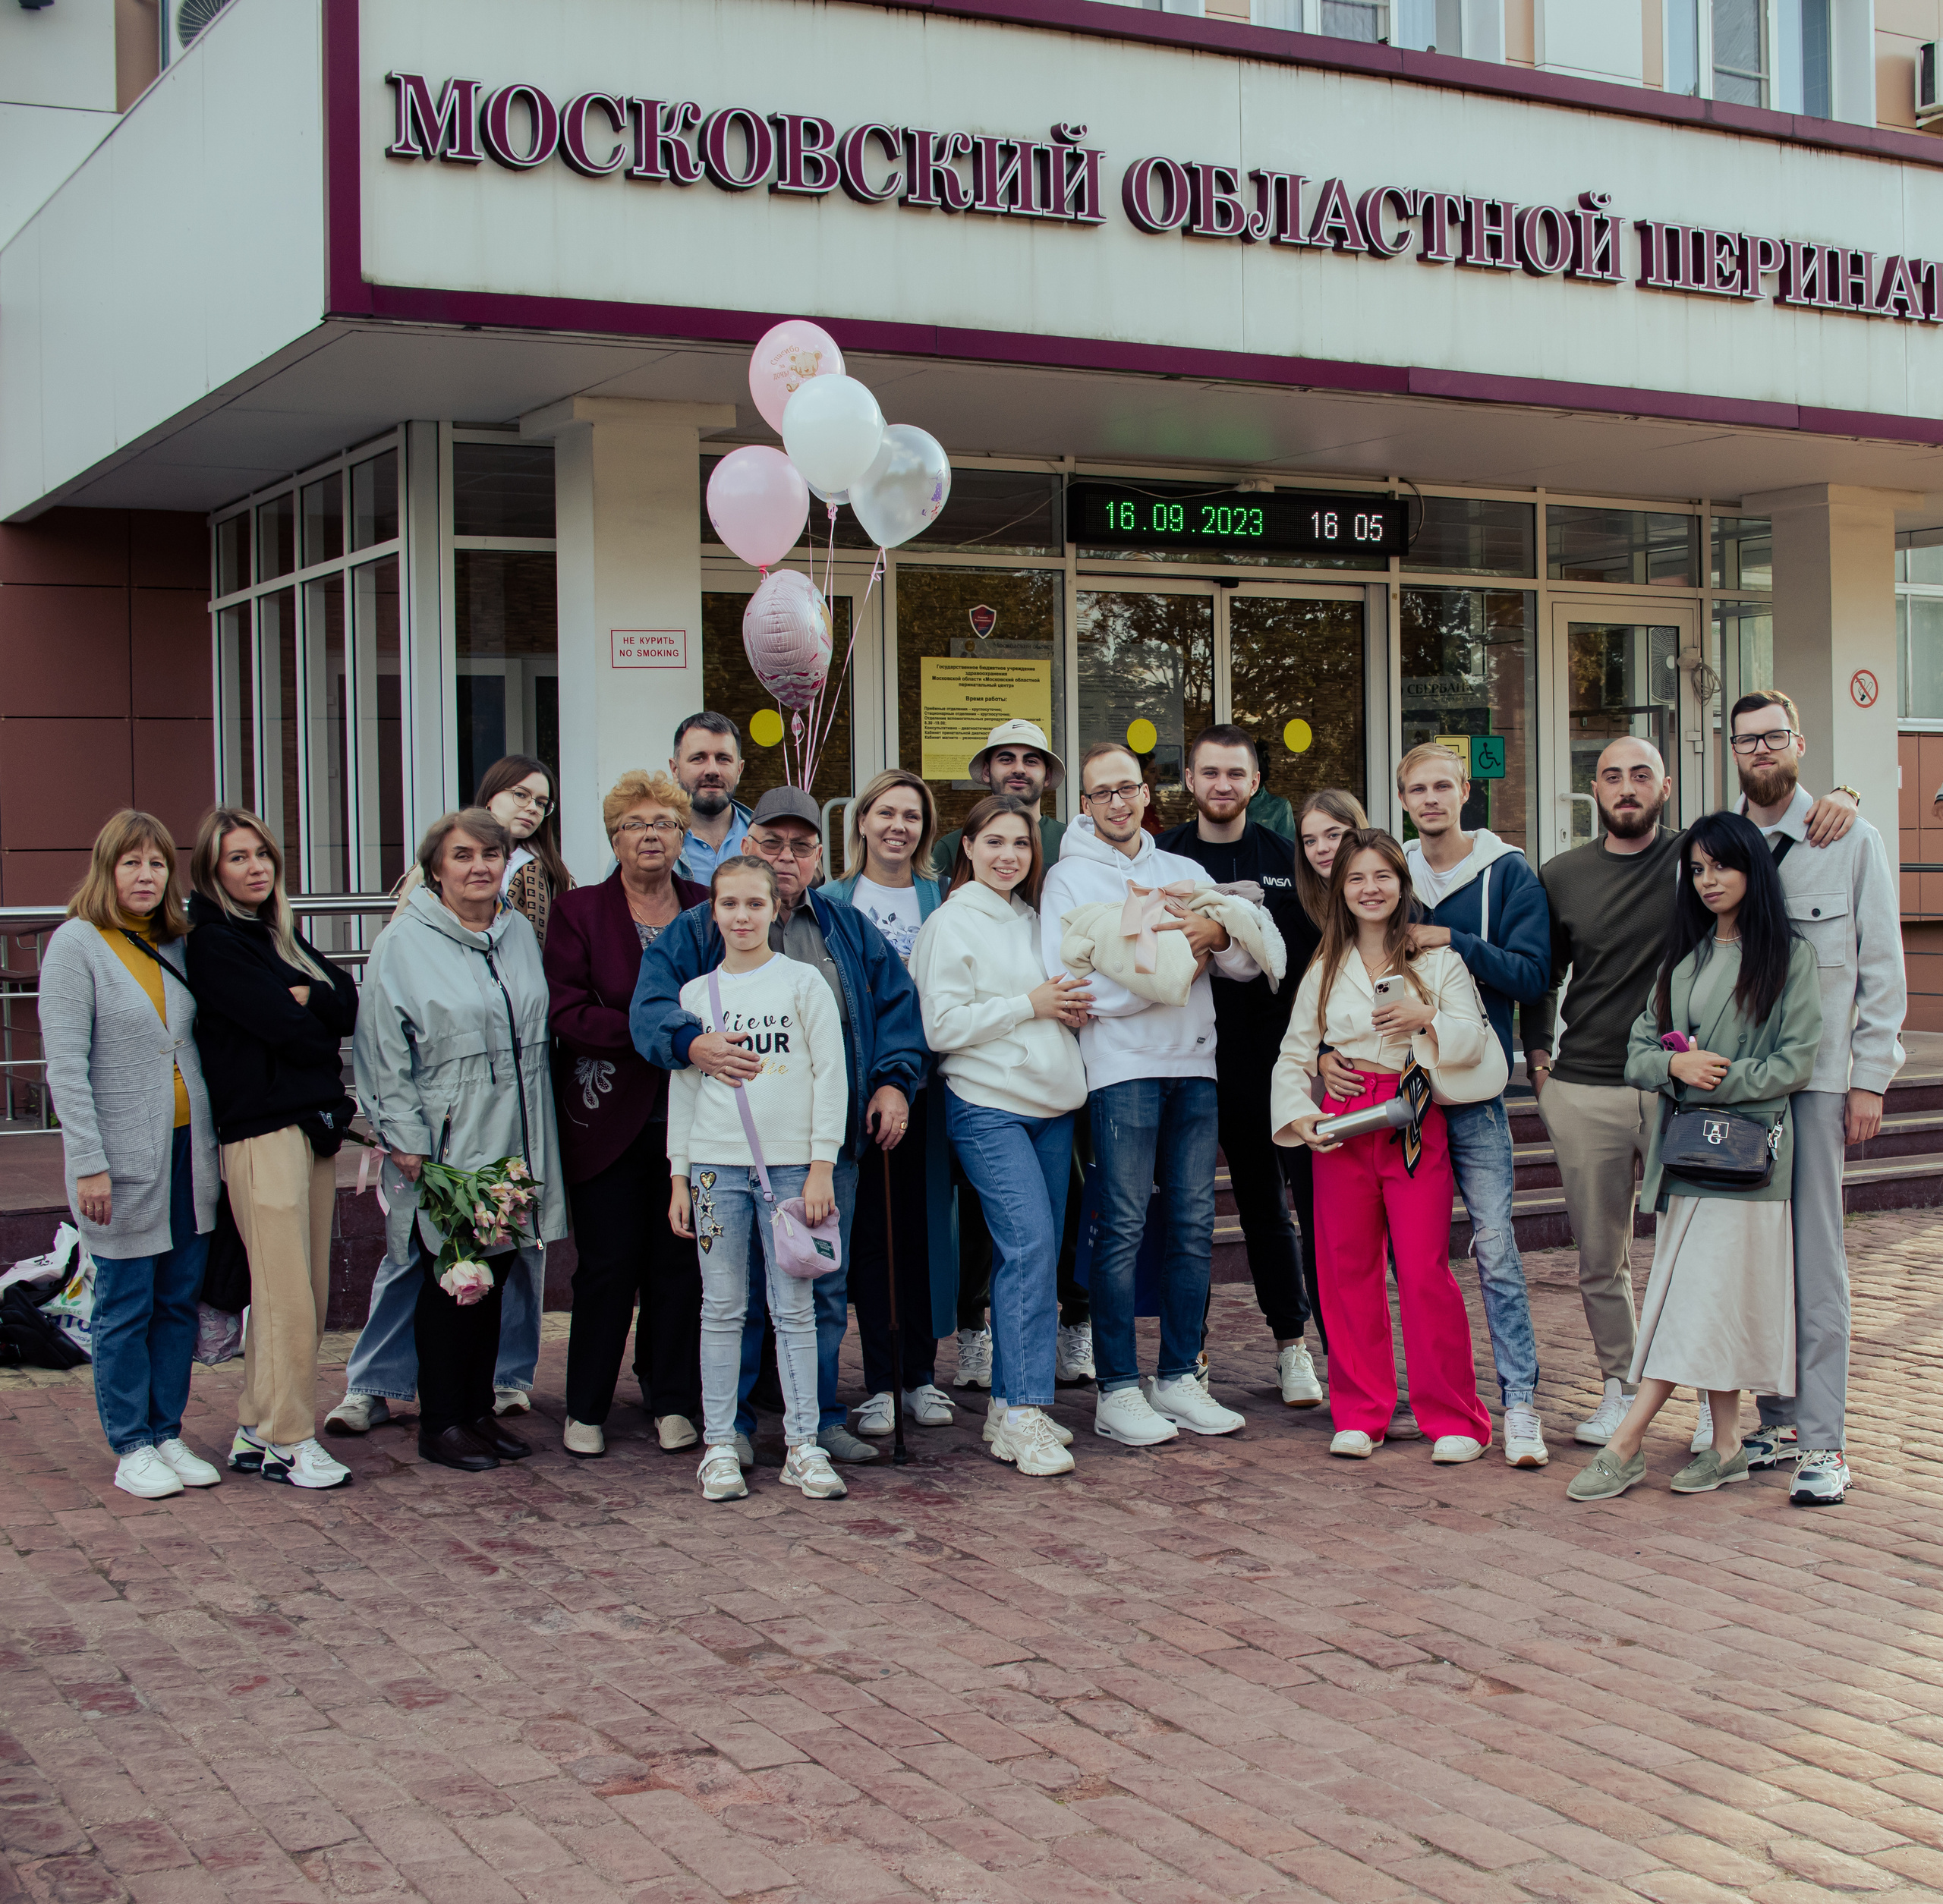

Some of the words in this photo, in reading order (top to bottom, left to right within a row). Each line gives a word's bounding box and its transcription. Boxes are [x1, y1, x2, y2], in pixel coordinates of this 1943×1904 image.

[386, 70, 1108, 226] МОСКОВСКИЙ
[1122, 154, 1629, 285] ОБЛАСТНОЙ
[1105, 501, 1264, 536] 16.09.2023
[640, 637, 675, 645] КУРИТЬ
[1263, 876, 1292, 887] NASA
